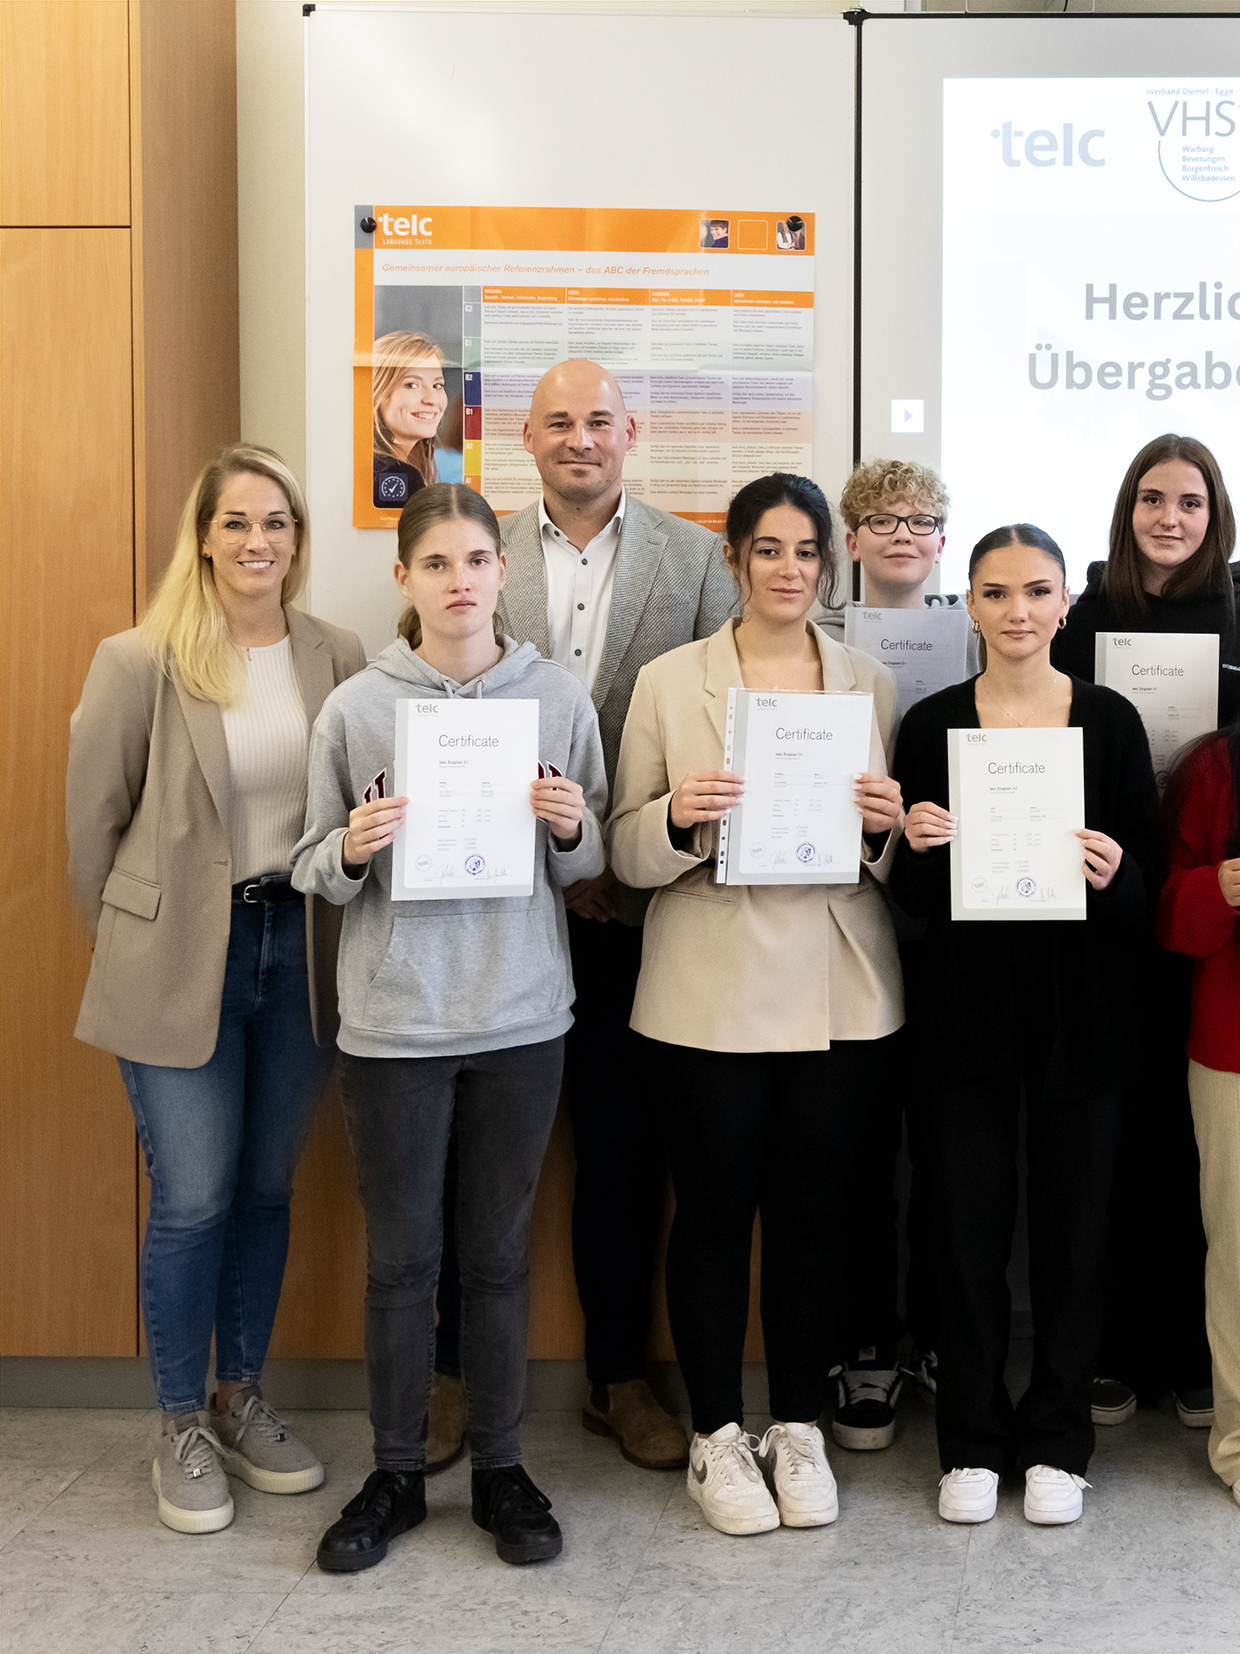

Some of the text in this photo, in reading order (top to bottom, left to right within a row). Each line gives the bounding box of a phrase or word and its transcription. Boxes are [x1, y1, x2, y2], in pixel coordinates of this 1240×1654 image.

[1216, 88, 1234, 96] Egge
[1147, 100, 1236, 137] VHS
[991, 120, 1106, 167] telc
[1182, 146, 1215, 155] Warburg
[1182, 156, 1226, 164] Beverungen
[1182, 165, 1229, 174] Borgentreich
[378, 213, 433, 236] telc
[382, 263, 443, 272] Gemeinsamer
[445, 264, 501, 274] europäischer
[504, 264, 575, 274] Referenzrahmen
[586, 266, 601, 274] das
[604, 266, 624, 275] ABC
[626, 267, 640, 275] der
[643, 267, 709, 277] Fremdsprachen
[863, 611, 882, 620] telc
[881, 639, 933, 651] Certificate
[1113, 637, 1132, 646] telc
[1132, 664, 1184, 676] Certificate
[755, 698, 777, 707] telc
[415, 704, 438, 713] telc
[776, 727, 833, 741] Certificate
[965, 733, 987, 742] telc
[439, 734, 499, 747] Certificate
[988, 762, 1045, 774] Certificate
